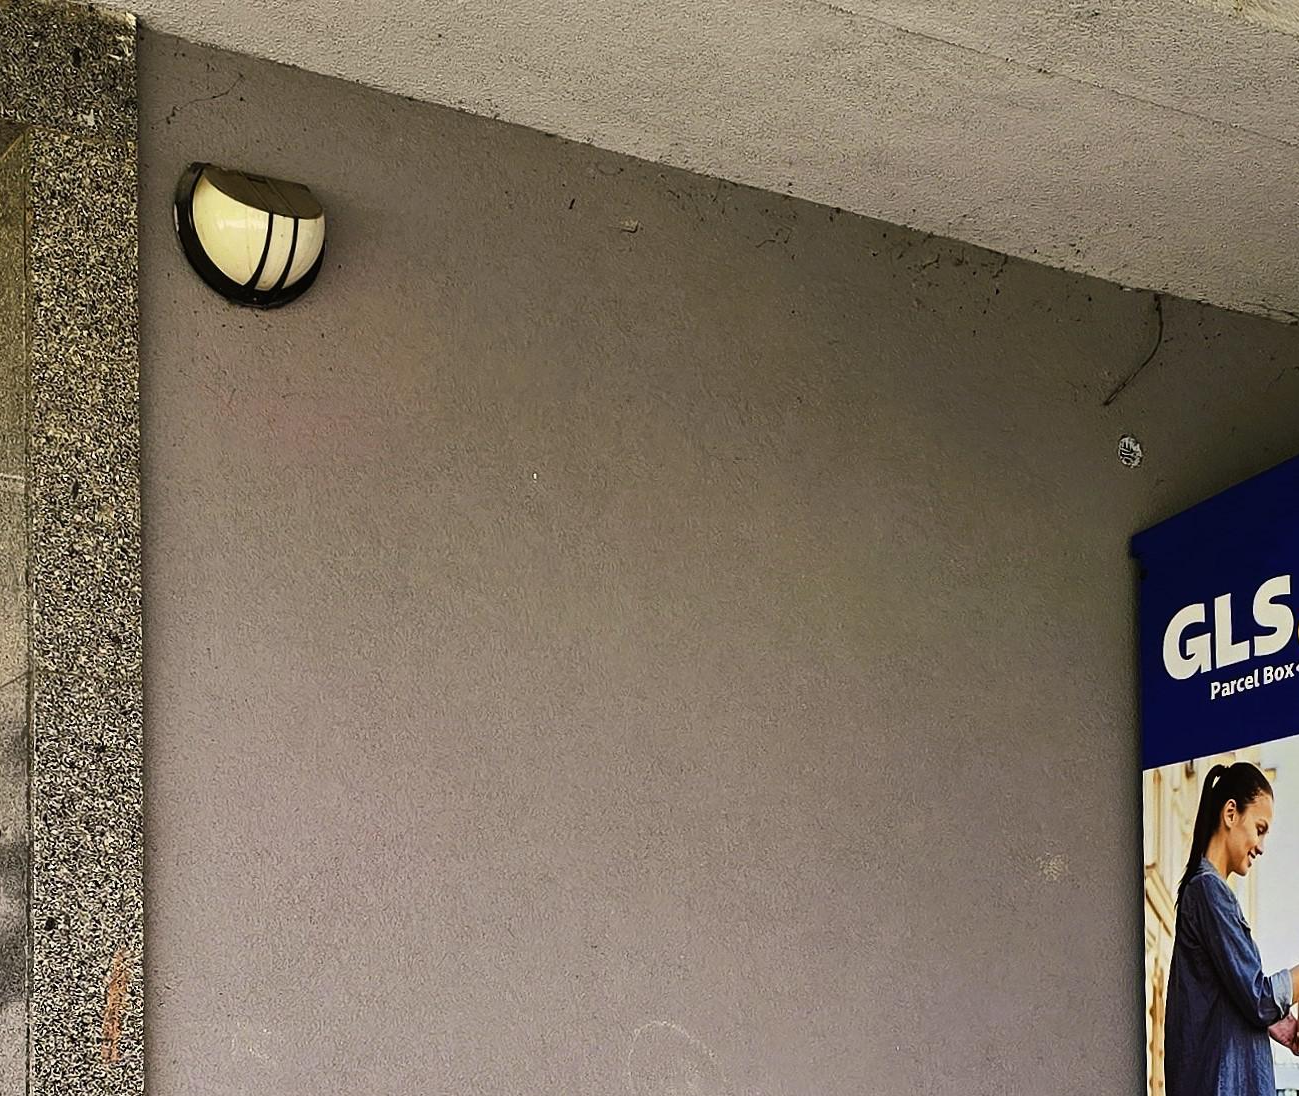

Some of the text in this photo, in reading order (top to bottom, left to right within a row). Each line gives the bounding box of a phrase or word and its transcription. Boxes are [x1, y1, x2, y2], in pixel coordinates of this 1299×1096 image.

[1163, 575, 1294, 680] GLS
[1210, 662, 1295, 700] Parcel Box
